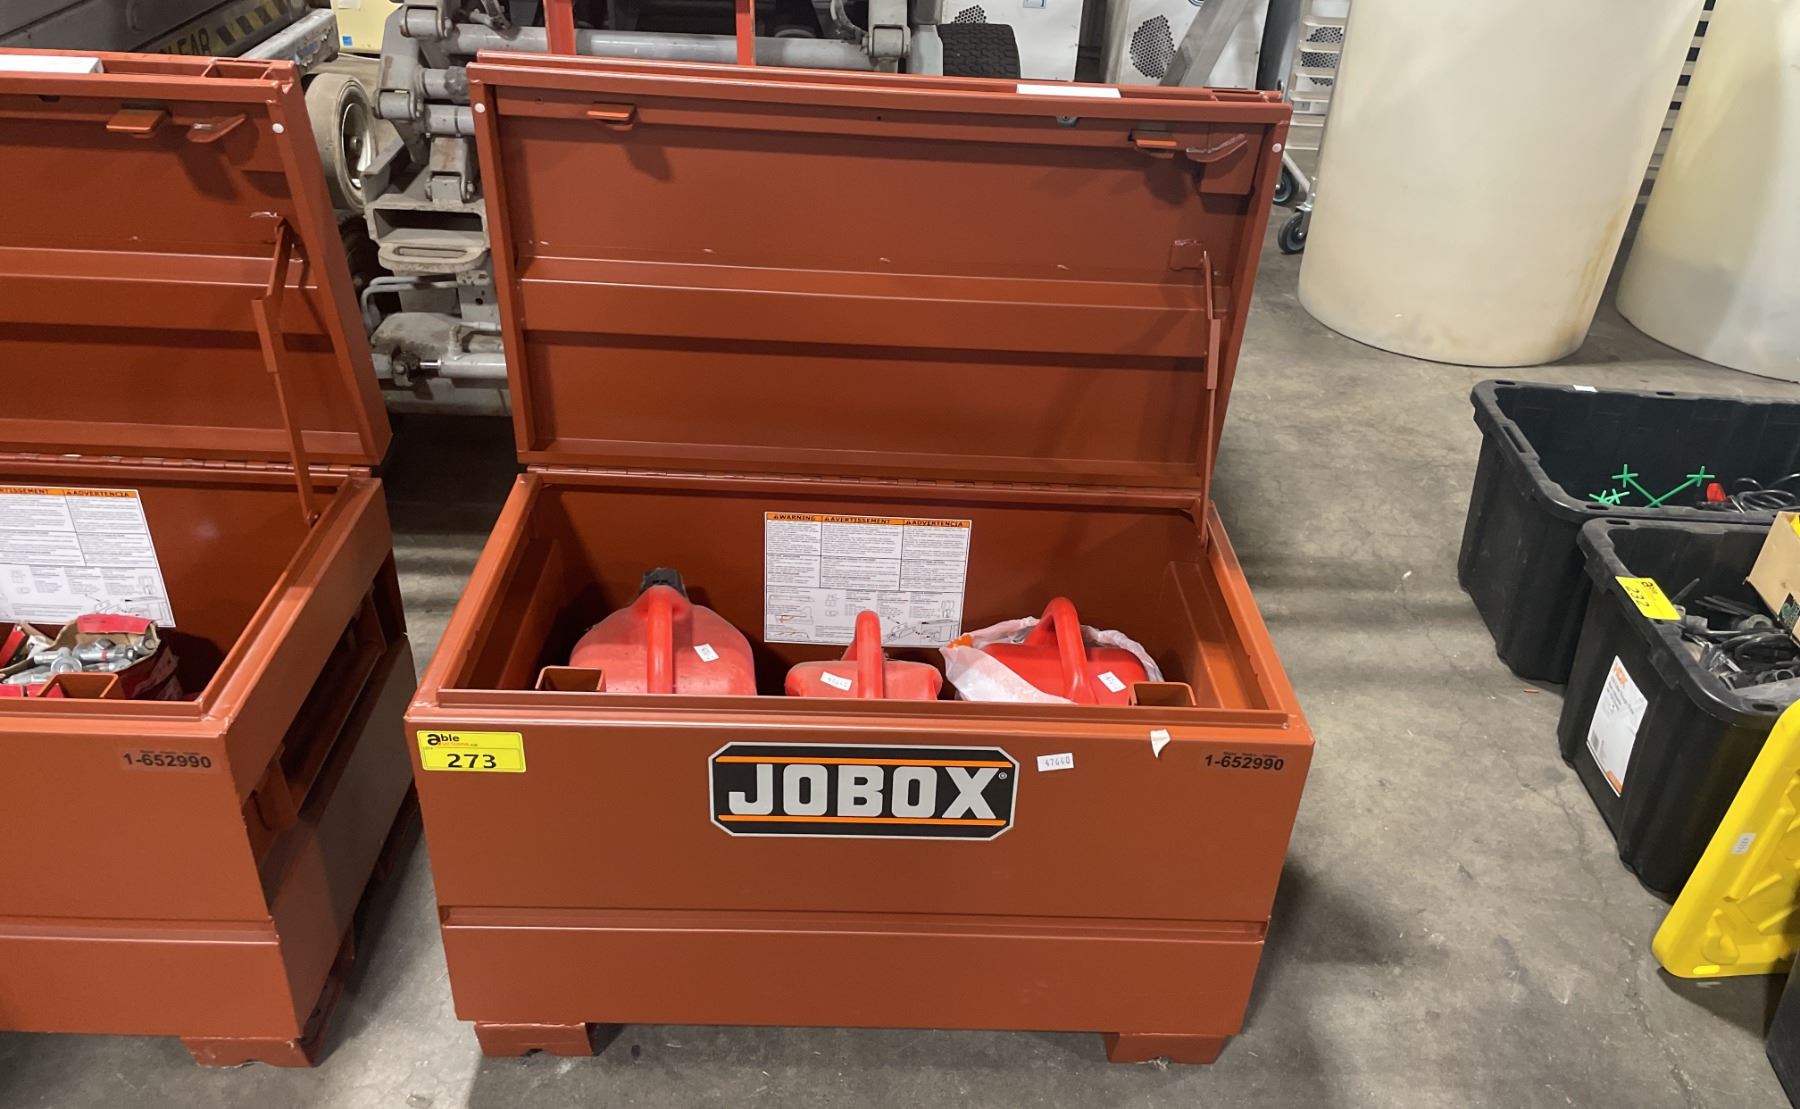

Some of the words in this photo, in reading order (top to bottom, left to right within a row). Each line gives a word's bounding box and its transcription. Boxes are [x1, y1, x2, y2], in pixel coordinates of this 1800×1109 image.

[831, 516, 890, 525] AVERTISSEMENT
[910, 520, 963, 528] ADVERTENCIA
[427, 733, 460, 746] able
[123, 752, 212, 769] 1-652990
[446, 753, 497, 769] 273
[1205, 754, 1284, 771] 1-652990
[728, 763, 1000, 819] JOBOX
